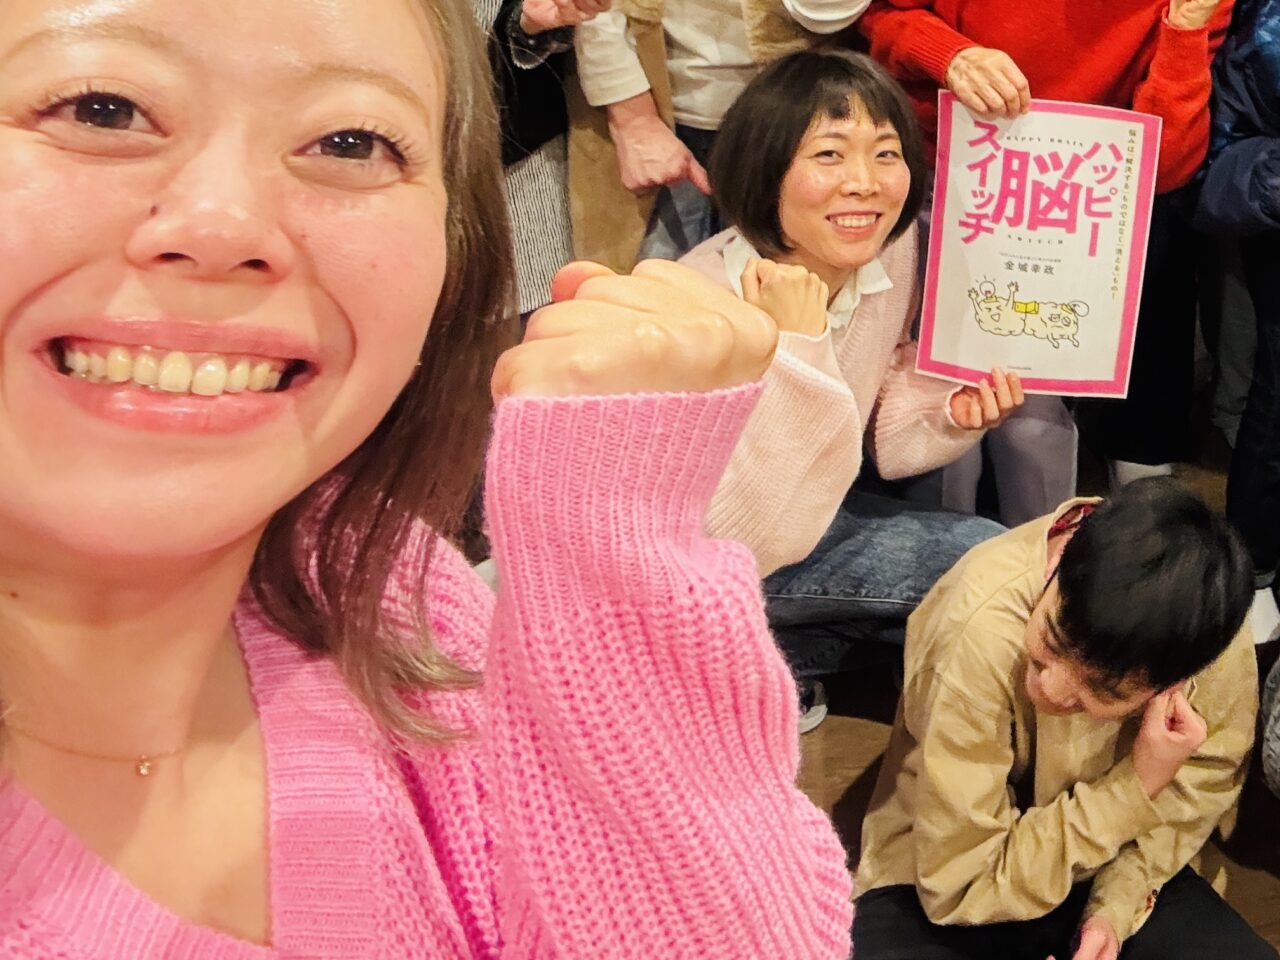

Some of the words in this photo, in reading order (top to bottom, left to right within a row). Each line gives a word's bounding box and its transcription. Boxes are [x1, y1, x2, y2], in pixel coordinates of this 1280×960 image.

[959, 119, 1002, 244] スイッチ
[991, 147, 1085, 234] 脳
[1084, 141, 1124, 258] ハッピー
